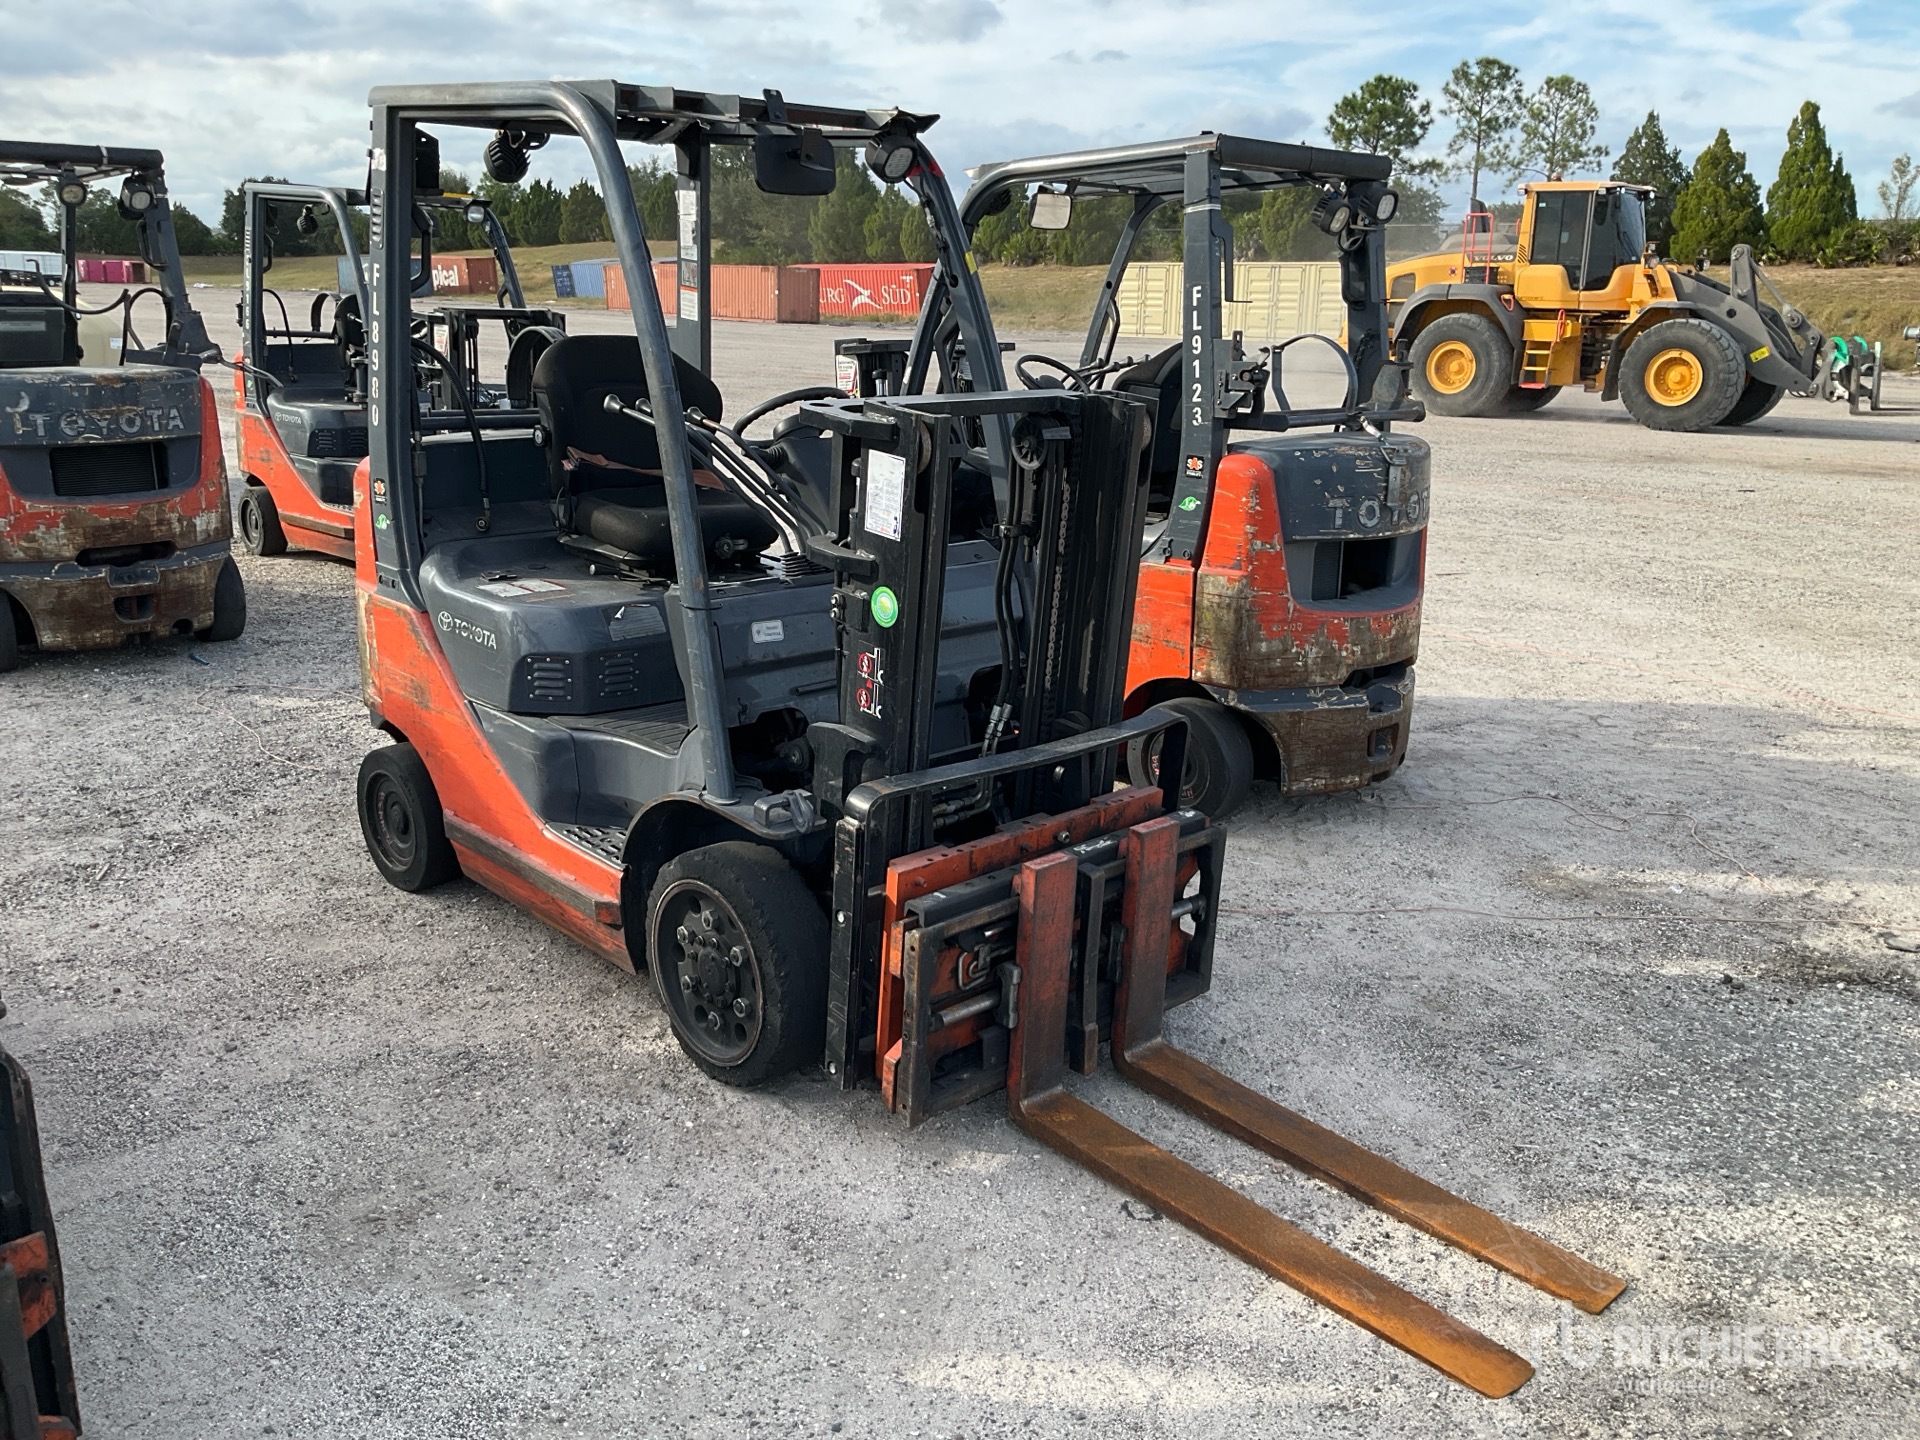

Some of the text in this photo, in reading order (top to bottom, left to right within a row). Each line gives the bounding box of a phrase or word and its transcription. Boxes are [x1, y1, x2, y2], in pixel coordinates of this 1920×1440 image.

[881, 284, 911, 305] SÜD
[371, 263, 380, 426] FL8980
[1191, 286, 1202, 426] FL9123
[29, 406, 185, 437] TOYOTA
[282, 413, 302, 424] TOYOTA
[454, 618, 497, 650] TOYOTA
